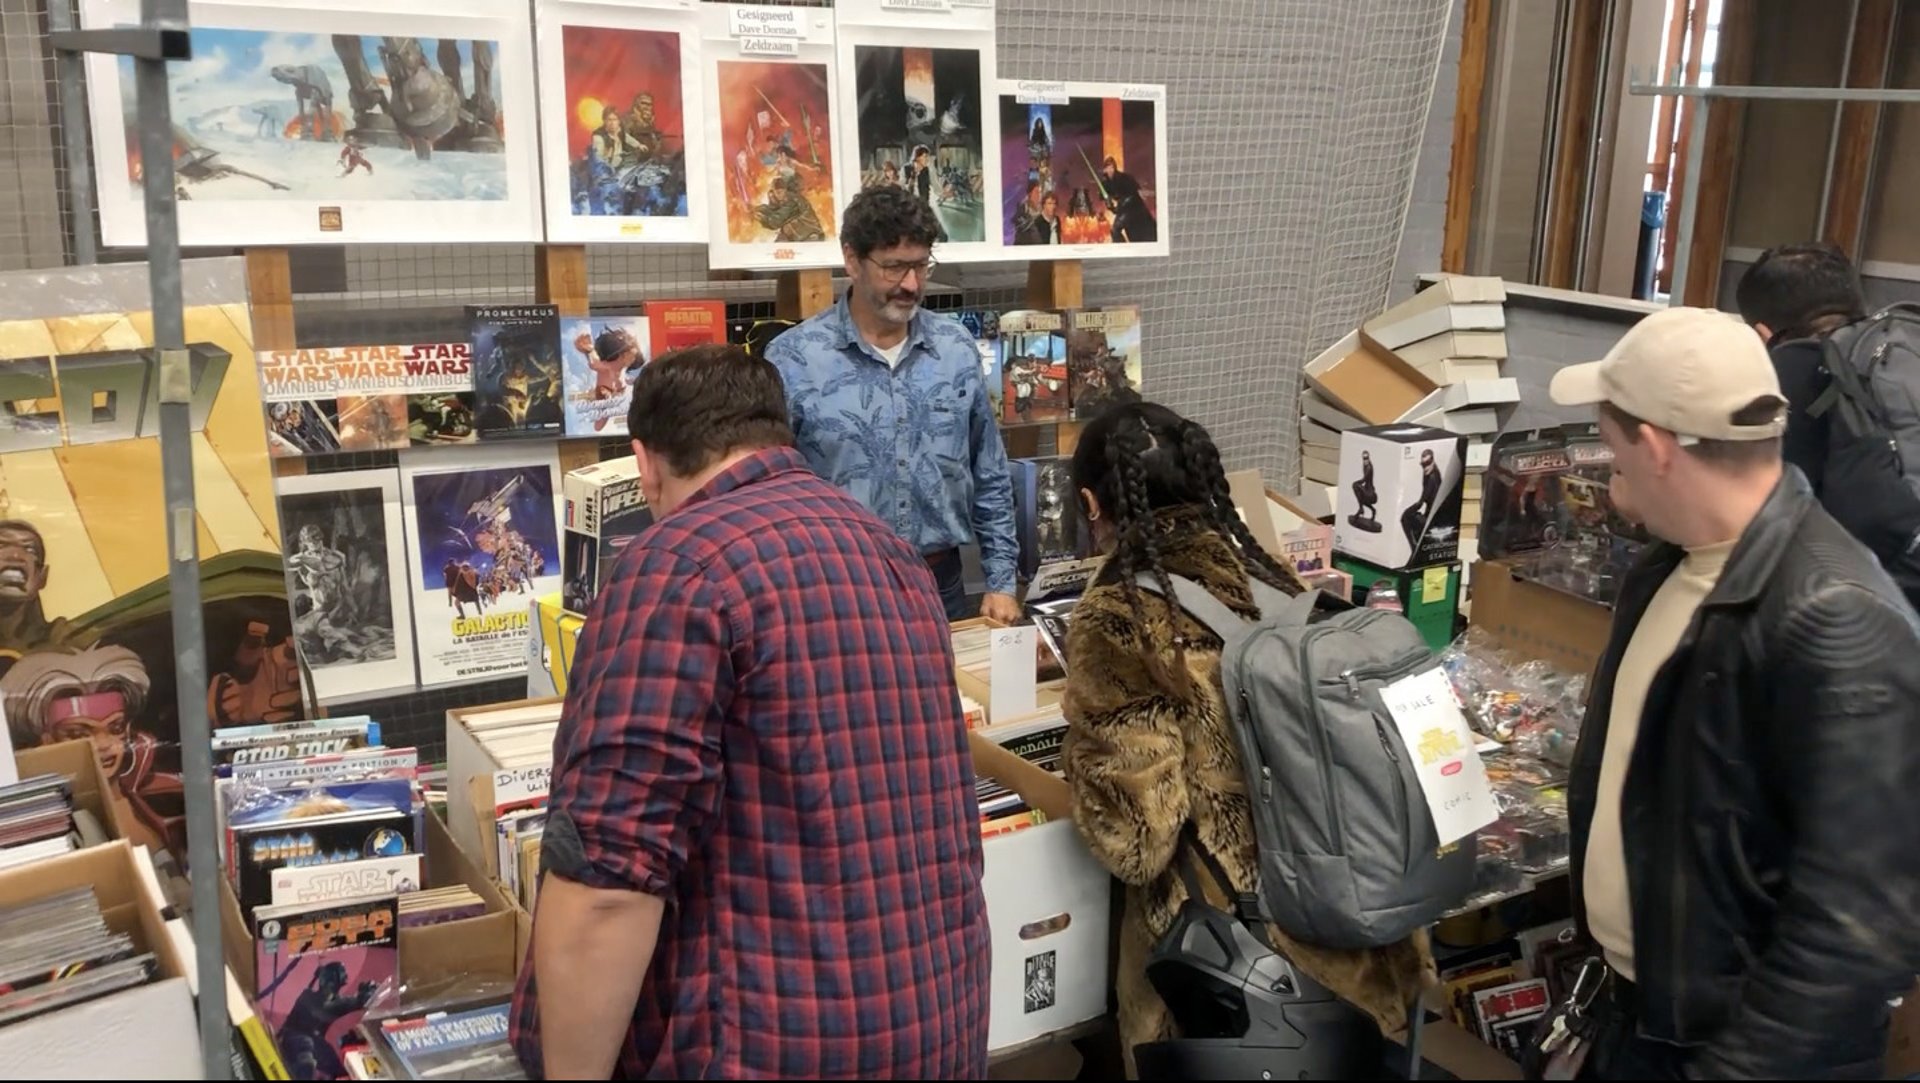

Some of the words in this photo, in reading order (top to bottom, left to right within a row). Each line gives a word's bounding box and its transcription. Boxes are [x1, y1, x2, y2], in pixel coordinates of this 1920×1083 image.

[737, 9, 793, 23] Gesigneerd
[738, 24, 761, 33] Dave
[763, 25, 797, 34] Dorman
[744, 39, 793, 52] Zeldzaam
[476, 308, 554, 317] PROMETHEUS
[260, 351, 336, 367] STAR
[335, 347, 405, 362] STAR
[403, 344, 473, 360] STAR
[263, 366, 336, 384] WARS
[336, 361, 404, 379] WARS
[403, 360, 472, 377] WARS
[263, 379, 338, 395] OMNIBUS
[338, 376, 405, 390] OMNIBUS
[405, 374, 472, 388] OMNIBUS
[466, 633, 499, 643] BATAILLE
[279, 764, 338, 778] TREASURY
[352, 759, 398, 769] EDITION
[298, 867, 388, 894] STAR
